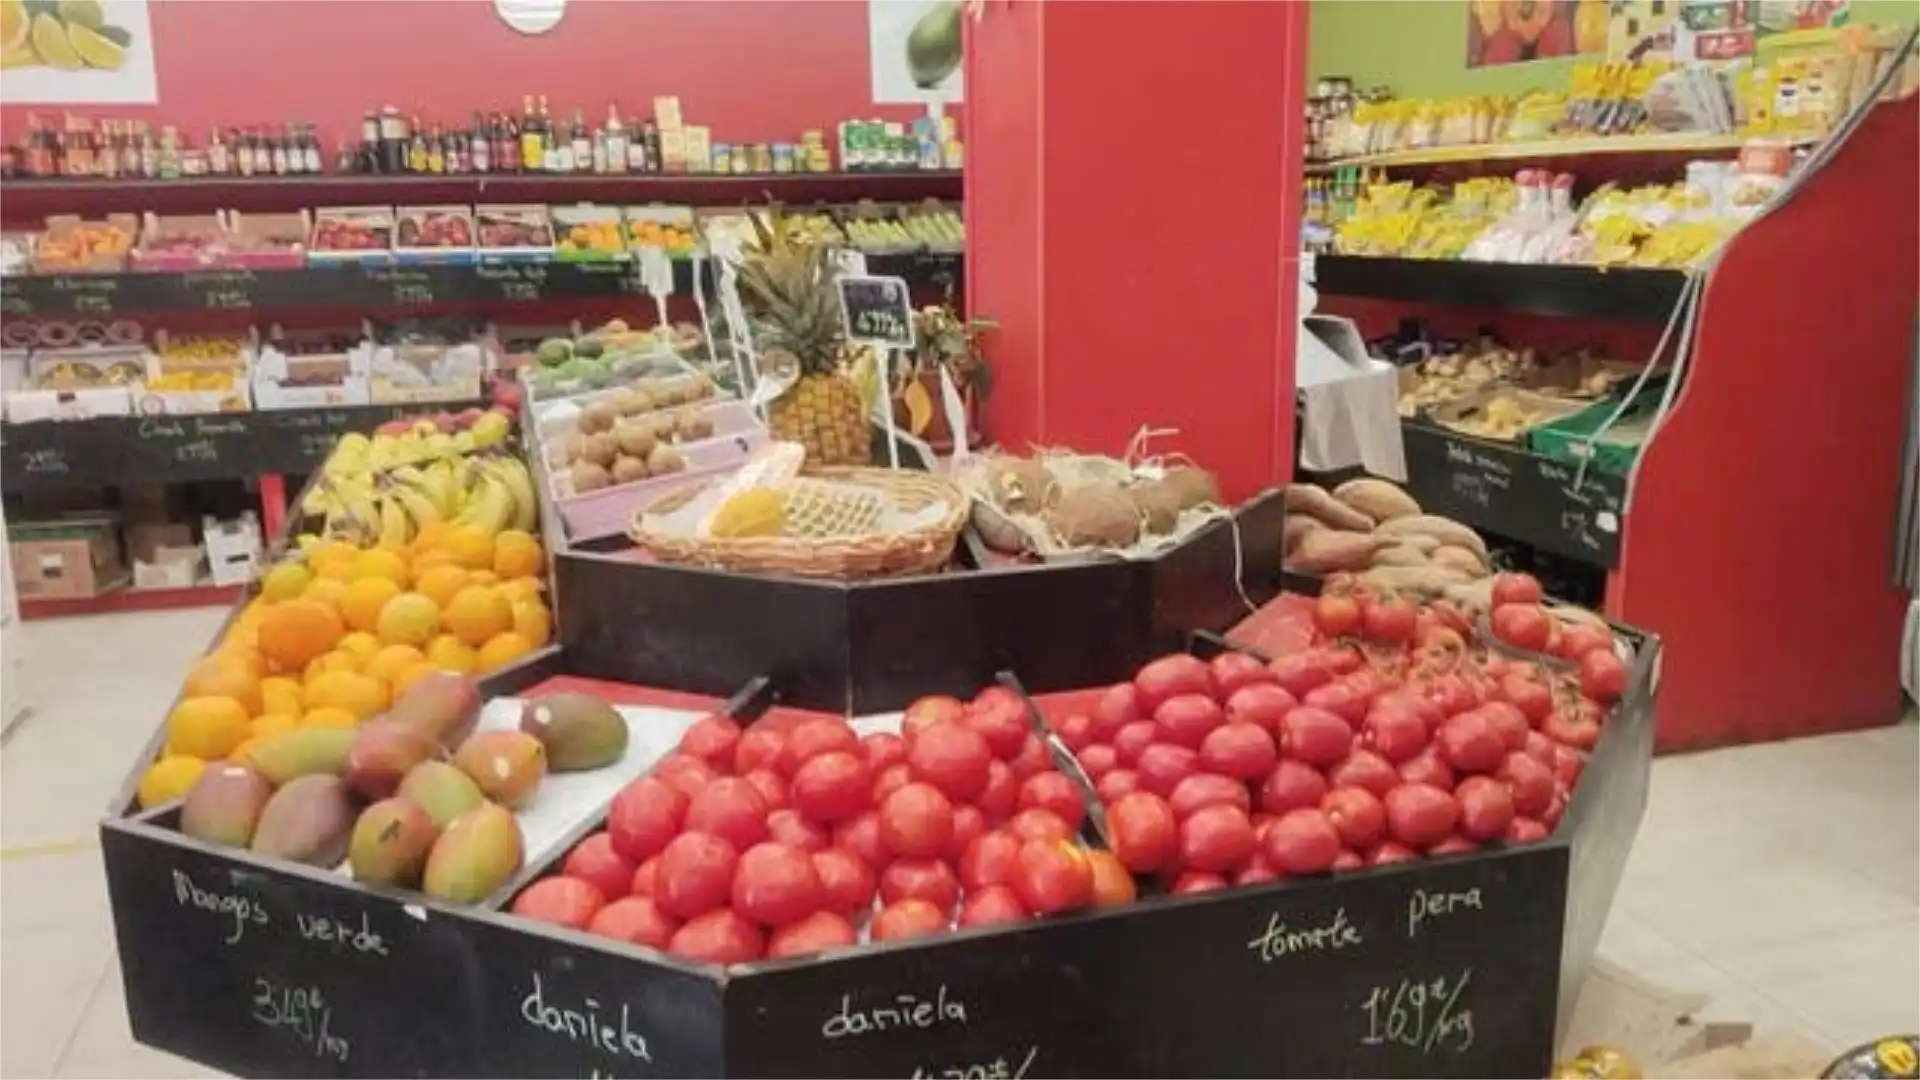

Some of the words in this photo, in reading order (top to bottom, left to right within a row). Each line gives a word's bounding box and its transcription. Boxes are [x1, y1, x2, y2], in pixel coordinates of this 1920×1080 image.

[297, 911, 389, 955] verde
[1408, 887, 1482, 937] pera
[521, 970, 653, 1063] daniela
[822, 983, 967, 1037] daniela
